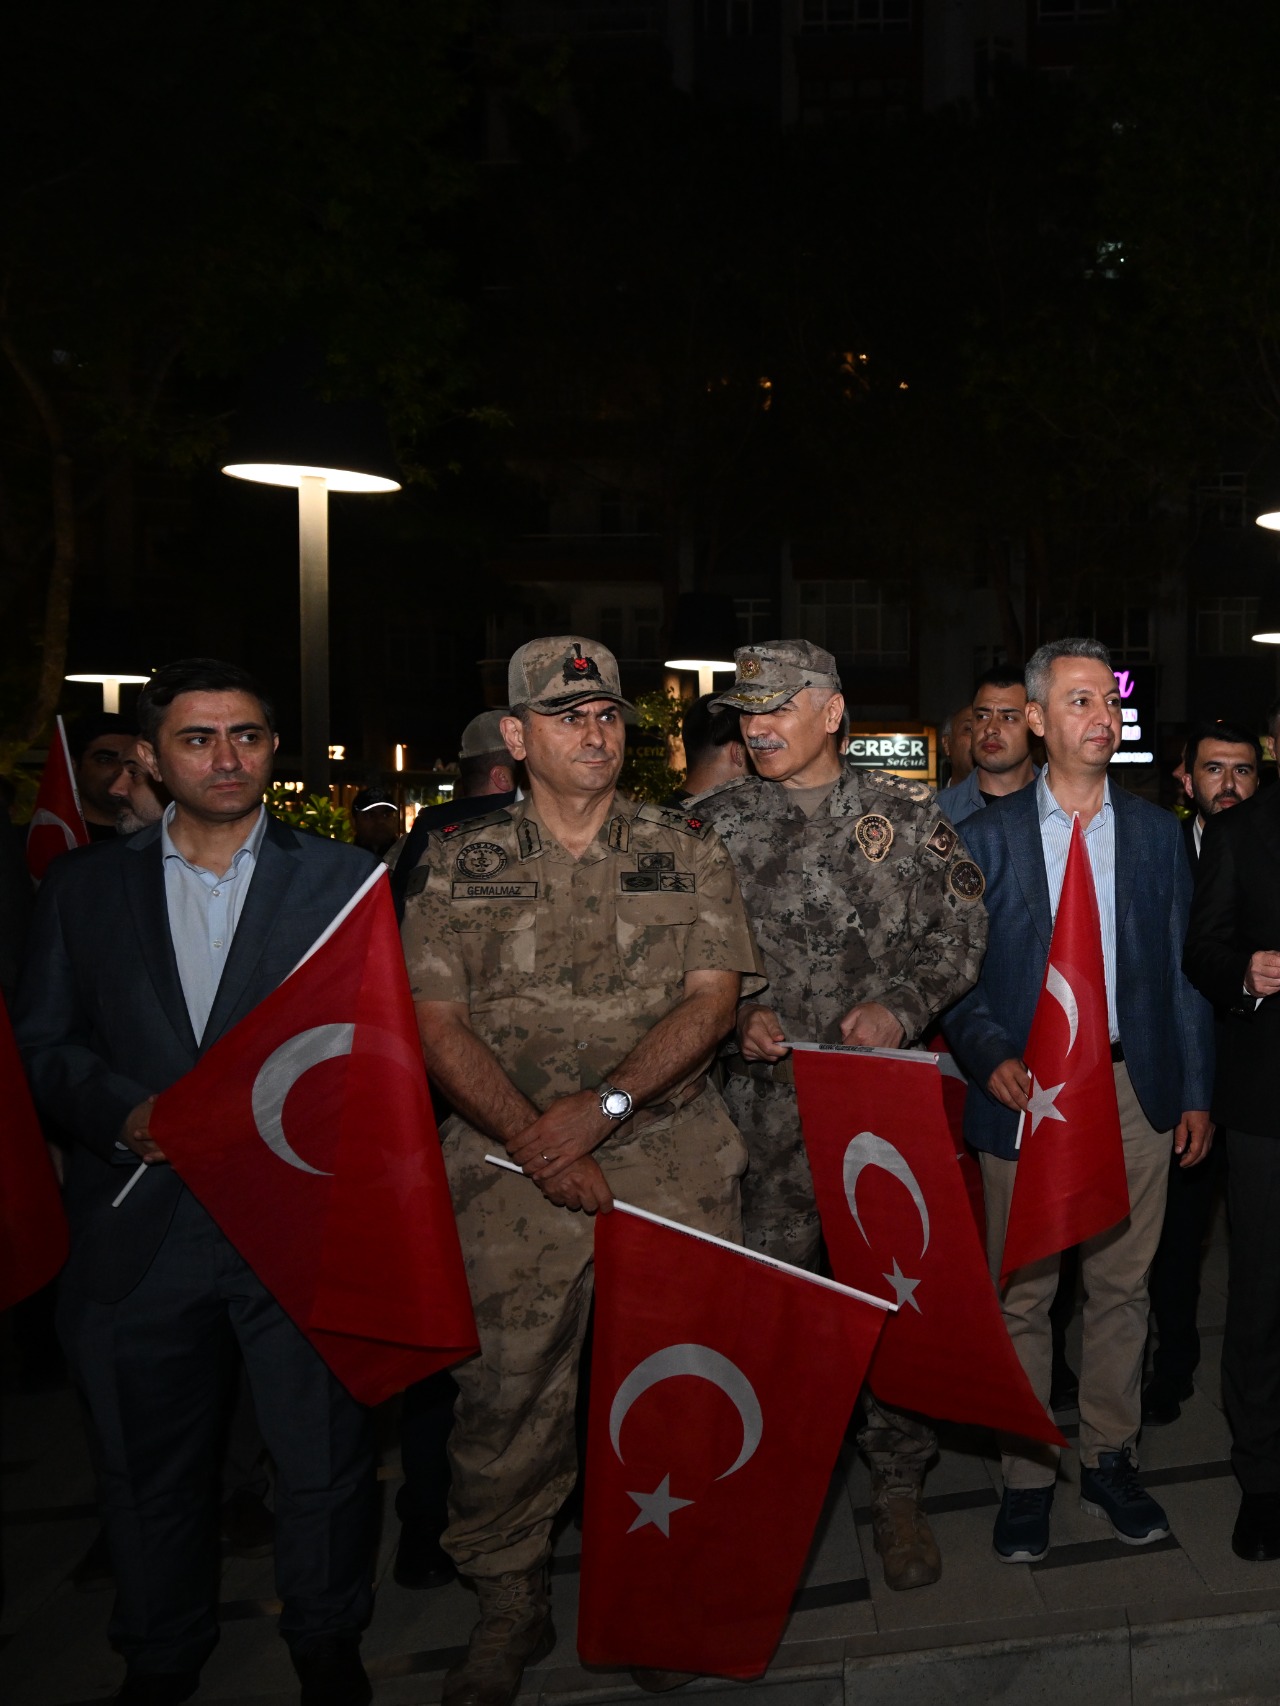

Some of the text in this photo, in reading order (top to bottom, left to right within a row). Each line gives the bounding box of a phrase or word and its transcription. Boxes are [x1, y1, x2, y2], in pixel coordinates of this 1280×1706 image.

[845, 739, 925, 757] ERBER
[886, 757, 926, 767] Selçuk
[467, 886, 521, 896] GEMALMAZ
